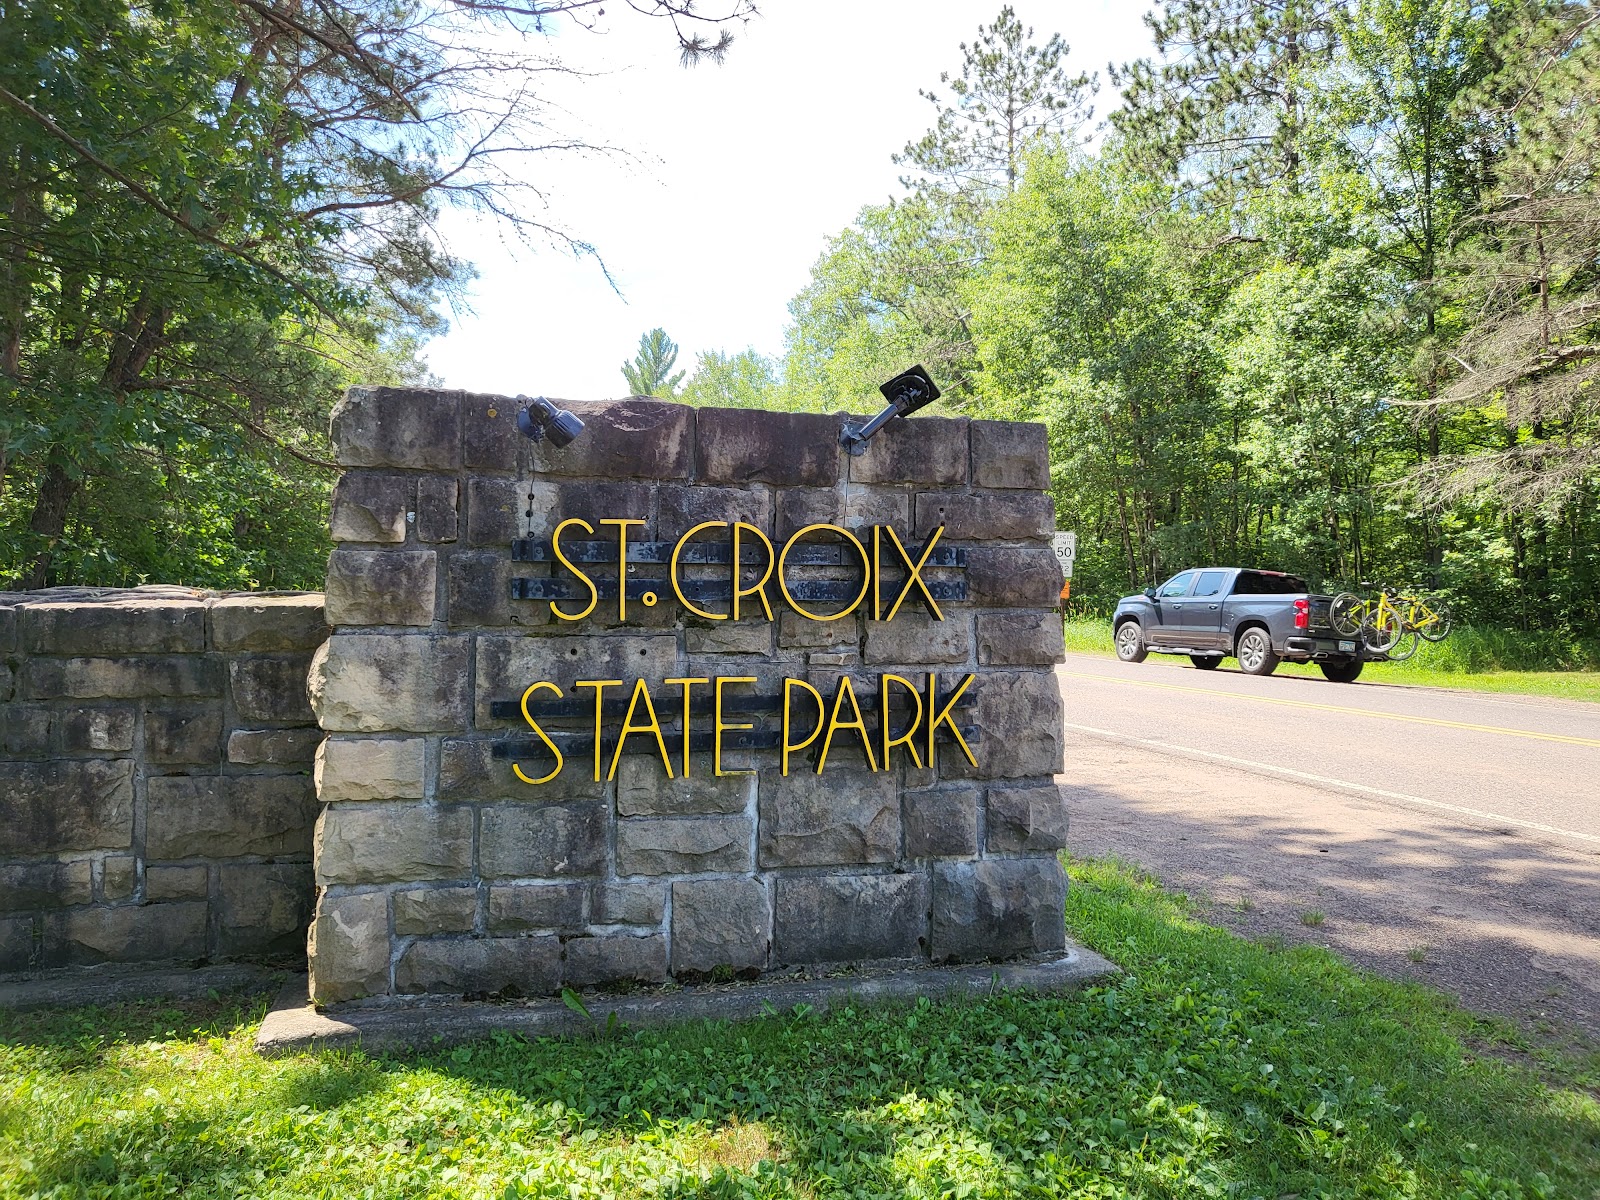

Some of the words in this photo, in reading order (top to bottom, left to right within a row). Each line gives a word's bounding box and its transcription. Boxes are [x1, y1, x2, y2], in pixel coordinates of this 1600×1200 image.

[549, 518, 658, 621] ST.
[670, 520, 945, 622] CROIX
[1056, 546, 1072, 558] 50
[512, 676, 757, 785] STATE
[782, 673, 979, 777] PARK
